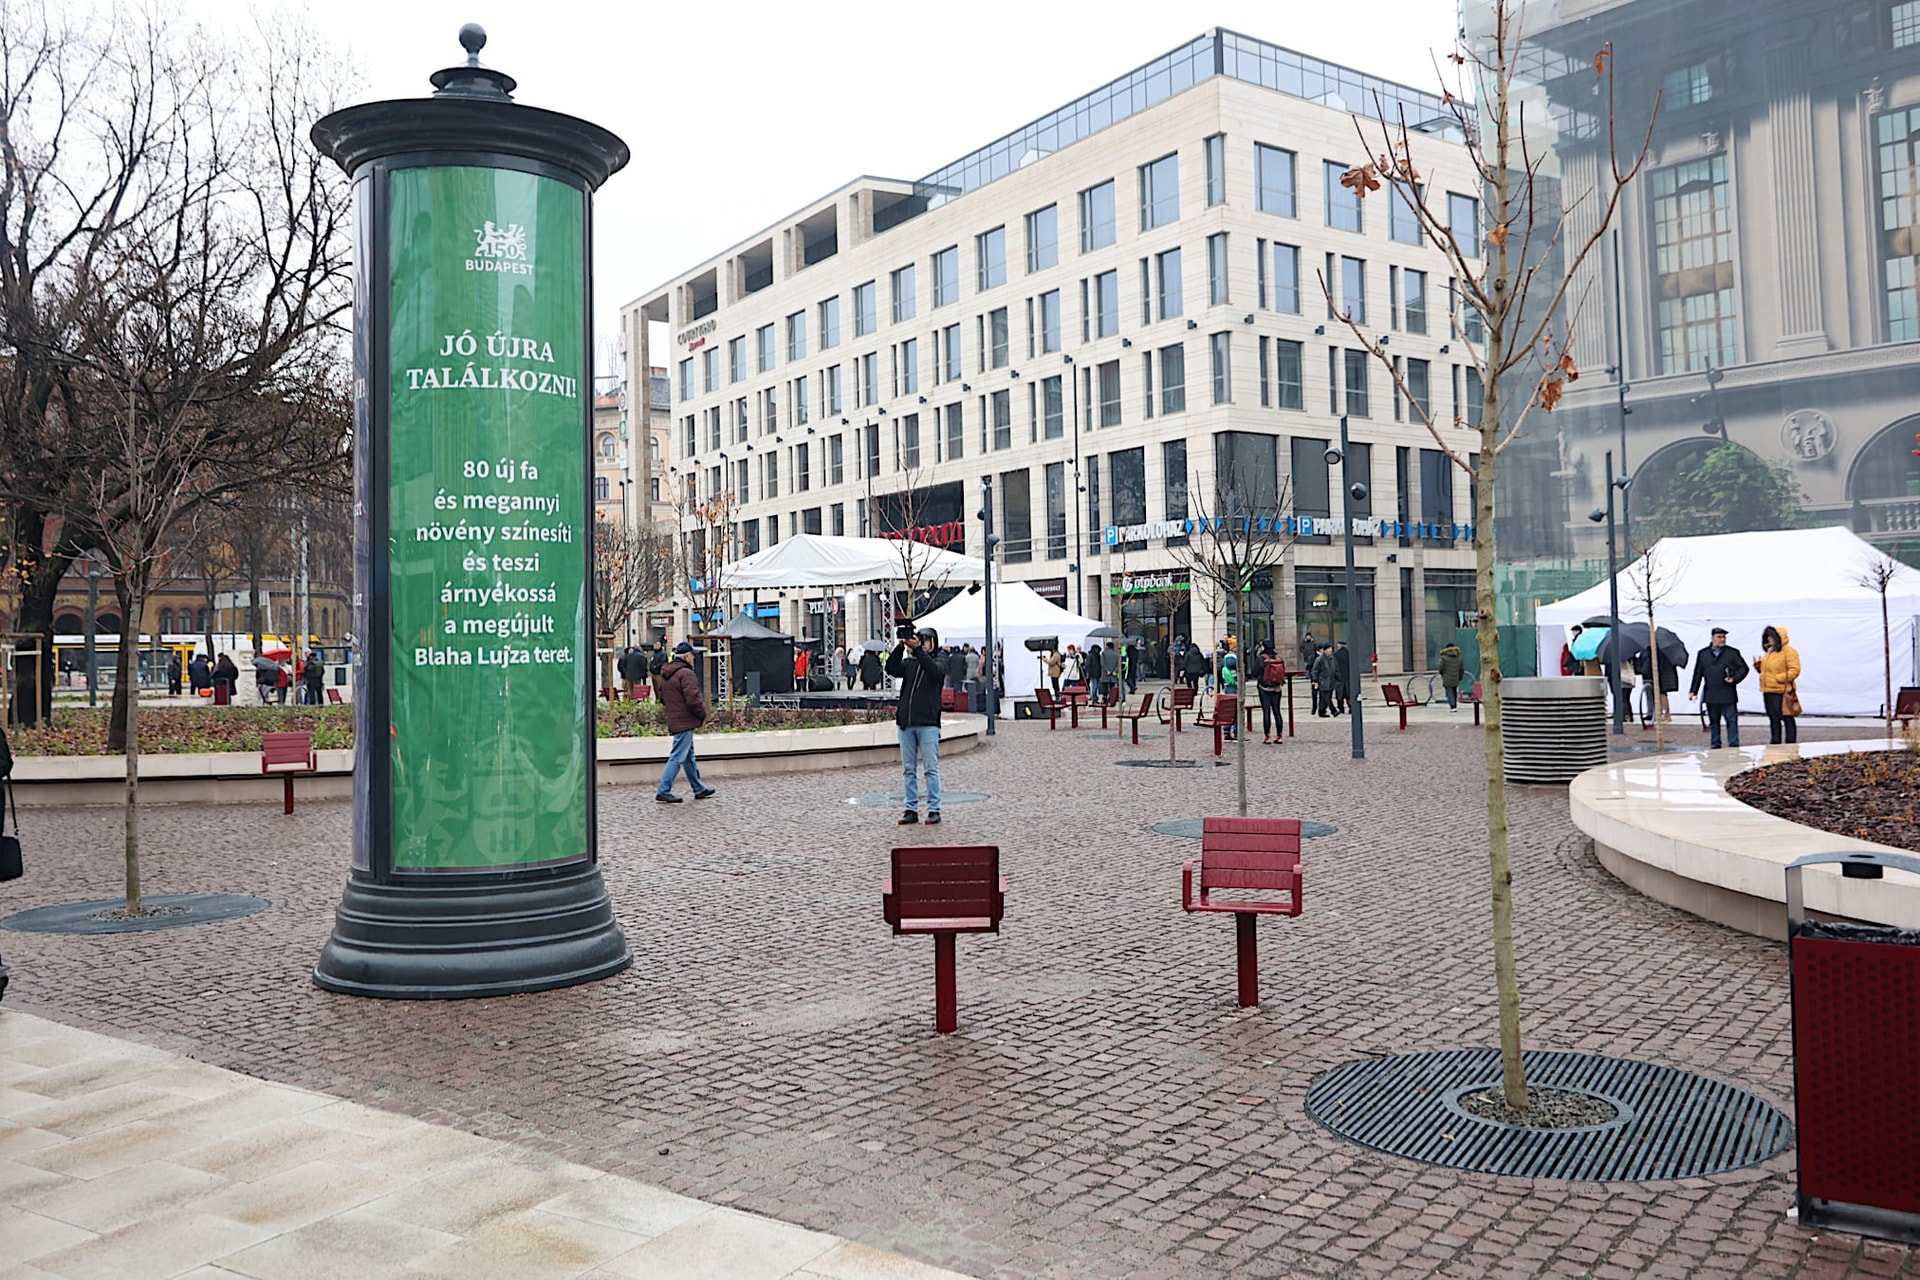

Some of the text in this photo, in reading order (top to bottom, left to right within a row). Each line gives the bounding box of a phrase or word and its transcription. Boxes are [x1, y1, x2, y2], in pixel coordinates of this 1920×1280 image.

[465, 259, 534, 276] BUDAPEST
[440, 329, 555, 363] JÓ ÚJRA
[406, 362, 577, 398] TALÁLKOZNI!
[463, 457, 538, 483] 80 új fa
[434, 488, 560, 516] és megannyi
[416, 518, 572, 544] növény színesíti
[463, 550, 540, 572] és teszi
[441, 581, 556, 607] árnyékossá
[444, 612, 554, 638] a megújult
[415, 645, 573, 669] Blaha Lujza teret.
